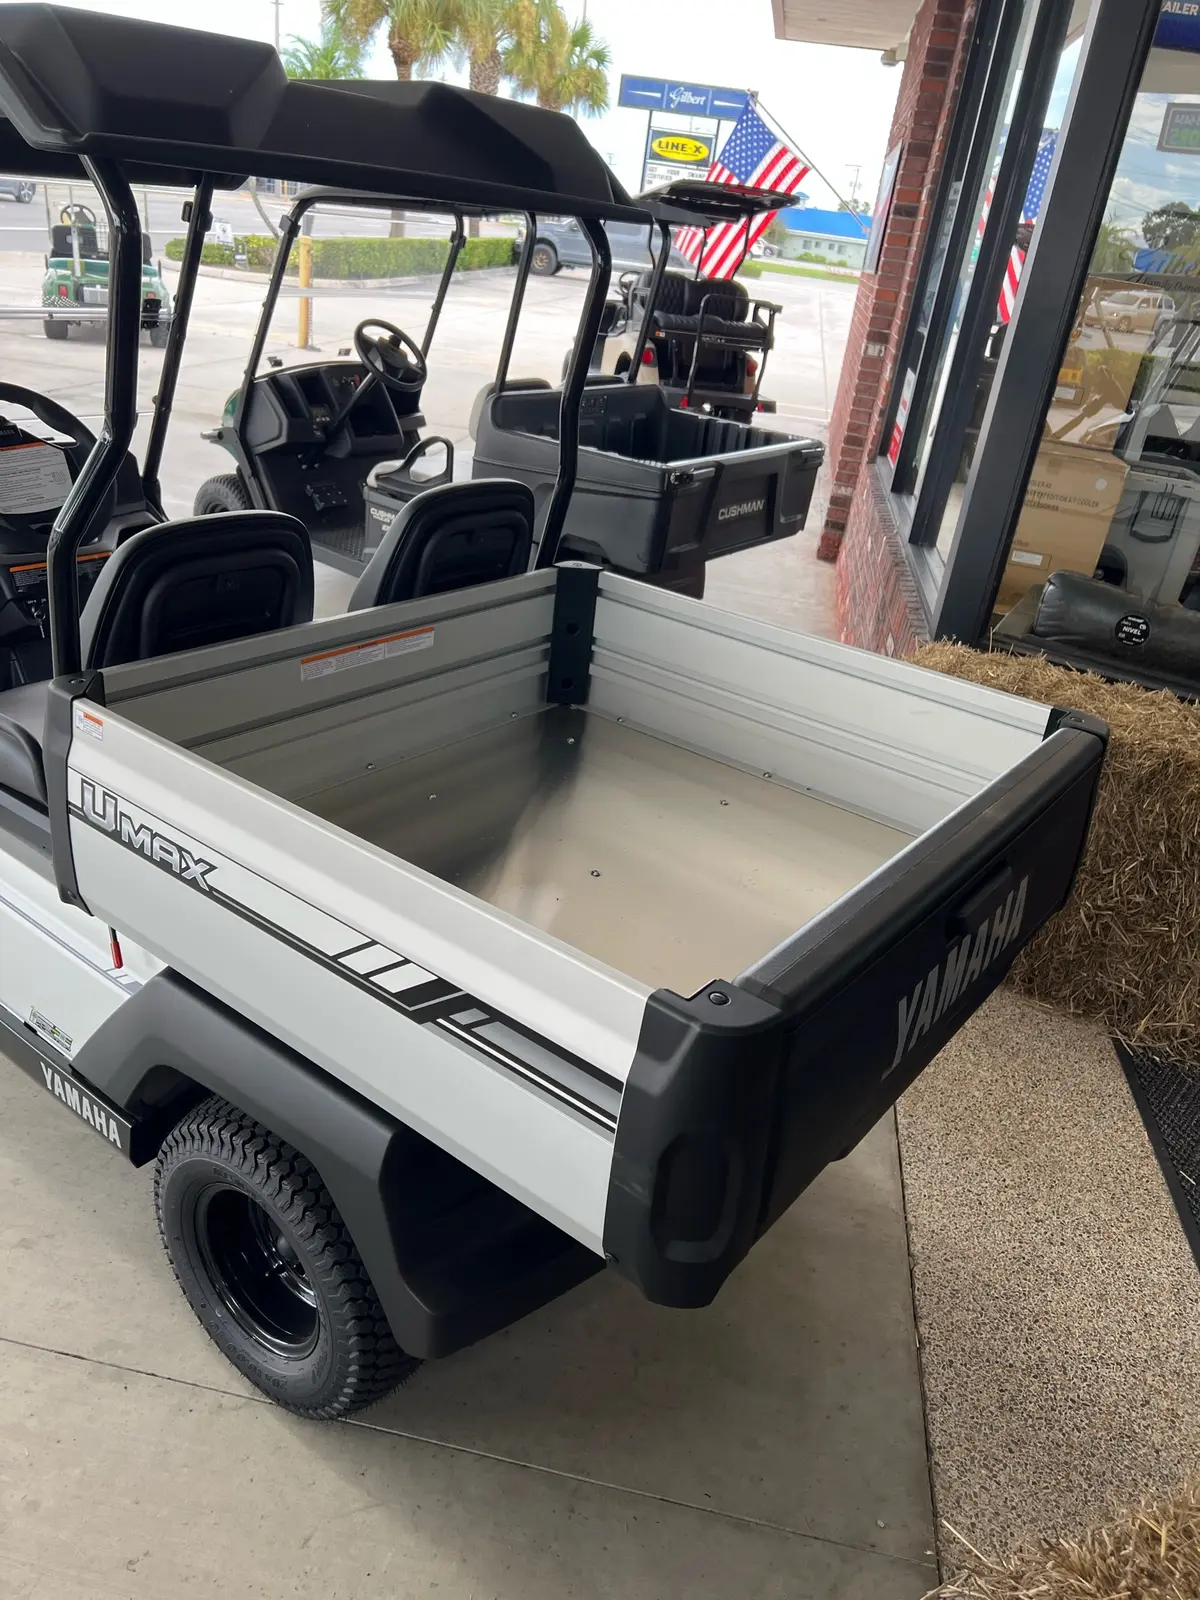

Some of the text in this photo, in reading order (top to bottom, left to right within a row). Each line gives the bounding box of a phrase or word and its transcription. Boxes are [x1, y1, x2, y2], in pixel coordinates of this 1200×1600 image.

[669, 86, 706, 108] Gilbert
[718, 499, 765, 520] CUSHMAN
[880, 874, 1029, 1083] YAMAHA
[40, 1061, 122, 1149] YAMAHA
